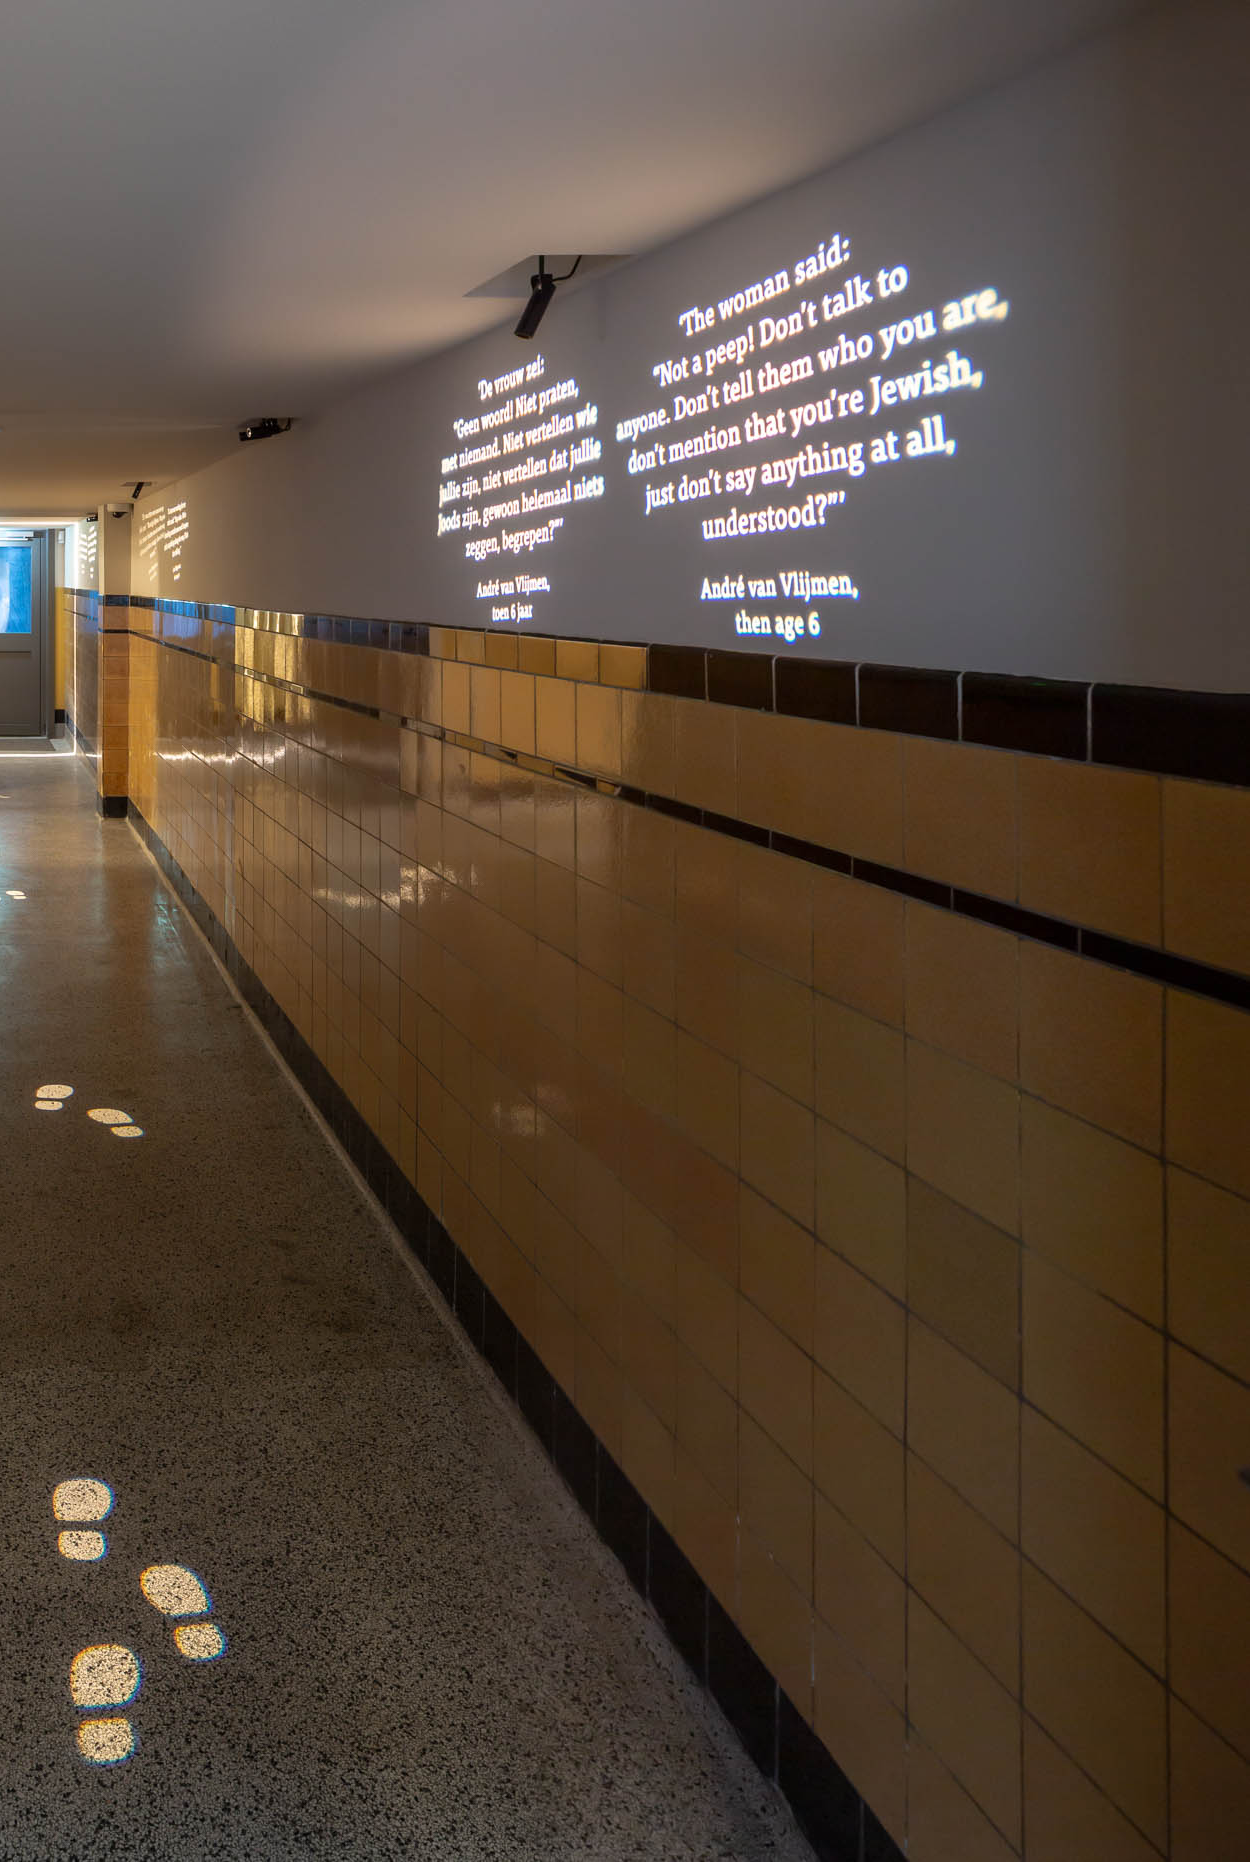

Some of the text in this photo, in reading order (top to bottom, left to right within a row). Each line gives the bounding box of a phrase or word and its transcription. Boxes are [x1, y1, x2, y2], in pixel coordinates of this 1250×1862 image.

[718, 270, 790, 322] woman
[794, 233, 851, 286] said:
[692, 355, 704, 376] a
[705, 325, 755, 373] peep!
[759, 298, 818, 349] Don't
[822, 274, 873, 320] talk
[876, 264, 910, 298] to
[494, 366, 525, 394] vrouw
[616, 287, 1010, 442] anyone. Don't tell them who you are,
[515, 392, 537, 418] Niet
[539, 378, 580, 414] praten,
[628, 350, 984, 474] don't mention that you're Jewish,
[441, 402, 598, 474] met niemand. Niet vertellen wie
[645, 414, 956, 515] just don't say anything at all,
[439, 437, 602, 508] jullie zijn, niet vertellen dat jullie
[437, 475, 605, 537] Joods zijn, gewoon helemaal niets
[465, 536, 500, 561] zeggen,
[476, 574, 550, 599] André van Vlijmen,
[492, 602, 533, 623] toen 6 jaar
[700, 570, 859, 602] André van Vlijmen,
[735, 609, 820, 642] then age 6
